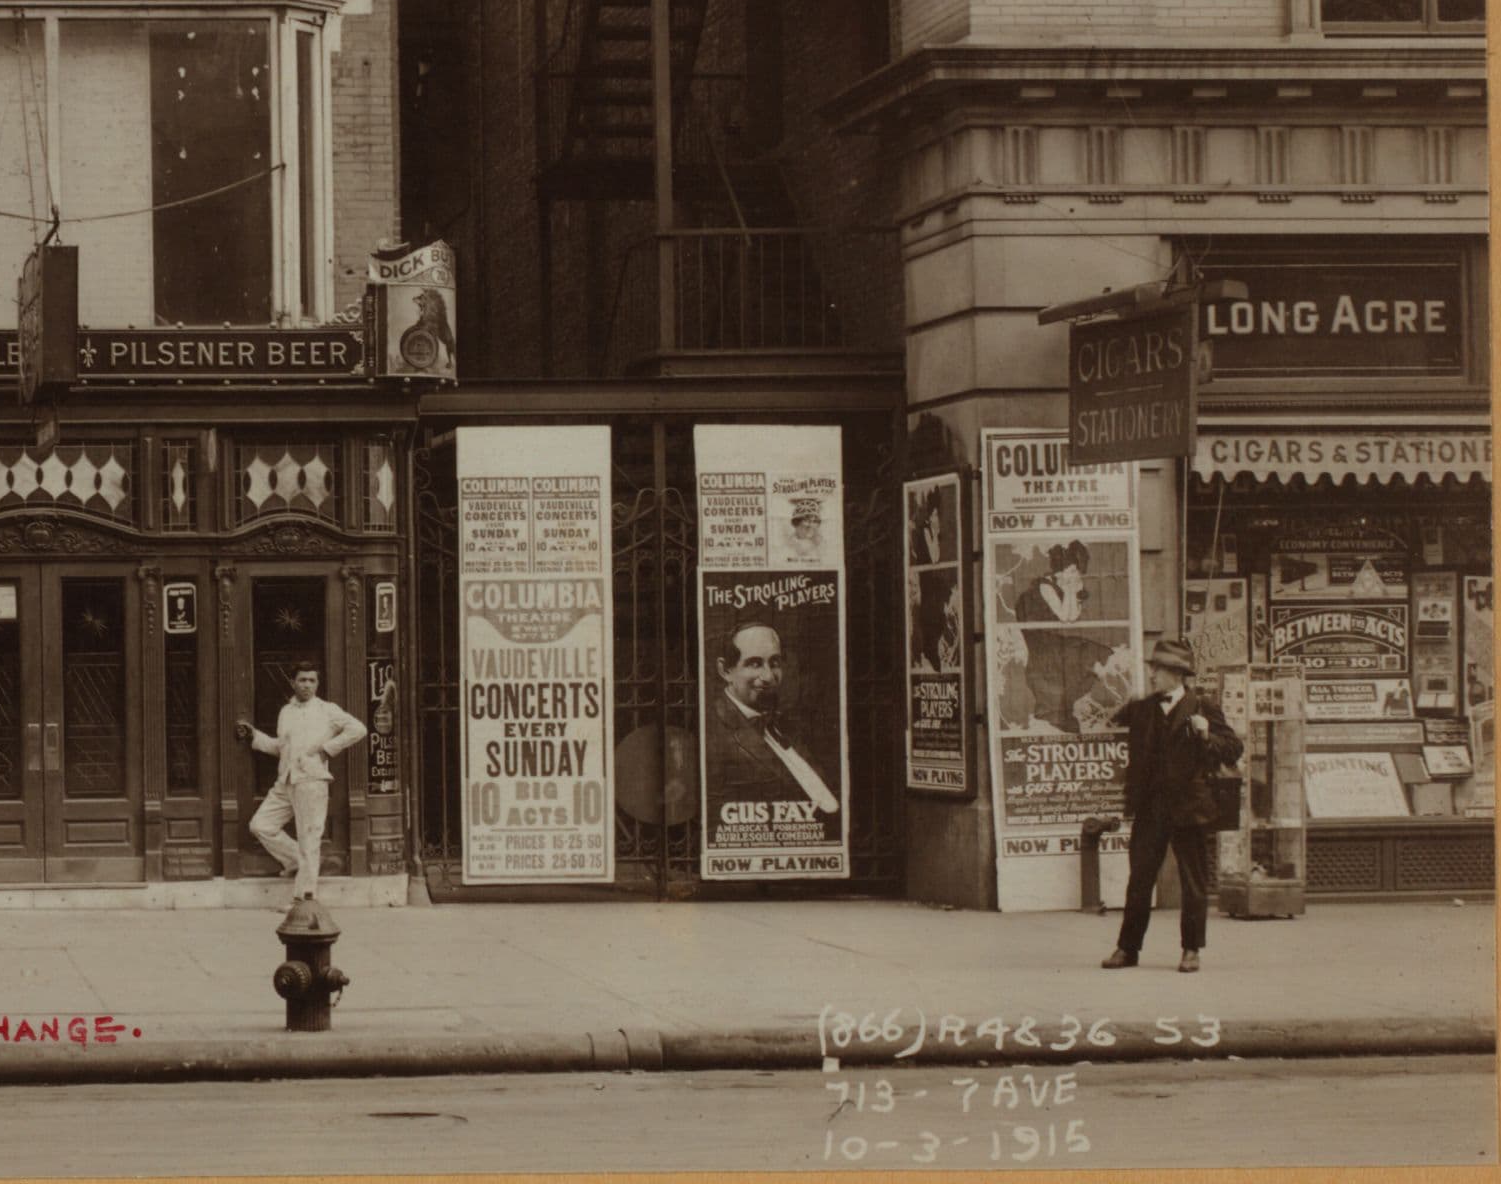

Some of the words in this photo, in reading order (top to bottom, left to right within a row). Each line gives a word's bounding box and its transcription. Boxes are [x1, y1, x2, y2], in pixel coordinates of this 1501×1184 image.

[380, 253, 424, 279] DICK
[1207, 300, 1320, 336] LONG
[1330, 294, 1447, 334] ACRE
[111, 342, 255, 366] PILSENER
[268, 342, 347, 366] BEER
[1077, 328, 1183, 382] CIGARS
[1076, 402, 1184, 448] STATIONERY
[1211, 439, 1324, 464] CIGARS
[1332, 444, 1348, 464] &
[996, 443, 1124, 477] COLU
[463, 479, 529, 493] COLUMBIA
[534, 478, 600, 492] COLUMBIA
[1022, 479, 1099, 494] THEATRE
[468, 501, 522, 511] VAUDEVILLE
[539, 500, 593, 510] VAUDEVILLE
[707, 497, 760, 506] VAUDEVILLE
[465, 511, 526, 521] CONCERTS
[536, 511, 597, 521] CONCERTS
[704, 507, 764, 517] CONCERTS
[710, 524, 757, 534] SUNDAY
[992, 515, 1036, 529] NOW
[1045, 513, 1130, 527] PLAYING
[472, 529, 519, 539] SUNDAY
[543, 528, 590, 538] SUNDAY
[465, 542, 475, 551] 10
[517, 541, 527, 551] 10
[537, 541, 547, 551] 10
[588, 541, 598, 551] 10
[705, 537, 714, 547] 10
[755, 537, 764, 547] 10
[466, 582, 603, 610] COLUMBIA
[706, 586, 733, 606] THE
[733, 574, 812, 609] STROLLING
[774, 583, 836, 611] PLAYERS
[497, 612, 573, 623] THEATRE
[1274, 613, 1352, 652] BETWEEN
[1364, 616, 1405, 647] ACTS
[472, 647, 598, 679] VAUDEVILLE
[1304, 657, 1326, 668] 10
[368, 662, 395, 702] LIO
[470, 682, 600, 720] CONCERTS
[504, 722, 568, 738] EVERY
[485, 740, 588, 777] SUNDAY
[1026, 742, 1130, 769] STROLLING
[931, 769, 964, 785] PLAYING
[1026, 761, 1115, 782] PLAYERS
[1305, 758, 1389, 780] PRINTING
[1025, 782, 1054, 796] GUS
[1056, 781, 1083, 793] FAY
[471, 781, 501, 826] 10
[515, 780, 558, 800] BIG
[572, 780, 602, 826] 10
[506, 807, 568, 826] ACTS
[720, 801, 770, 825] GUS
[771, 800, 820, 823] FAY
[715, 831, 775, 843] BURLESQUE
[776, 830, 825, 841] COMEDIAN
[1006, 839, 1049, 854] NOW
[1060, 837, 1130, 852] PLYIN
[711, 859, 752, 872] NOW
[762, 856, 840, 871] PLAYING
